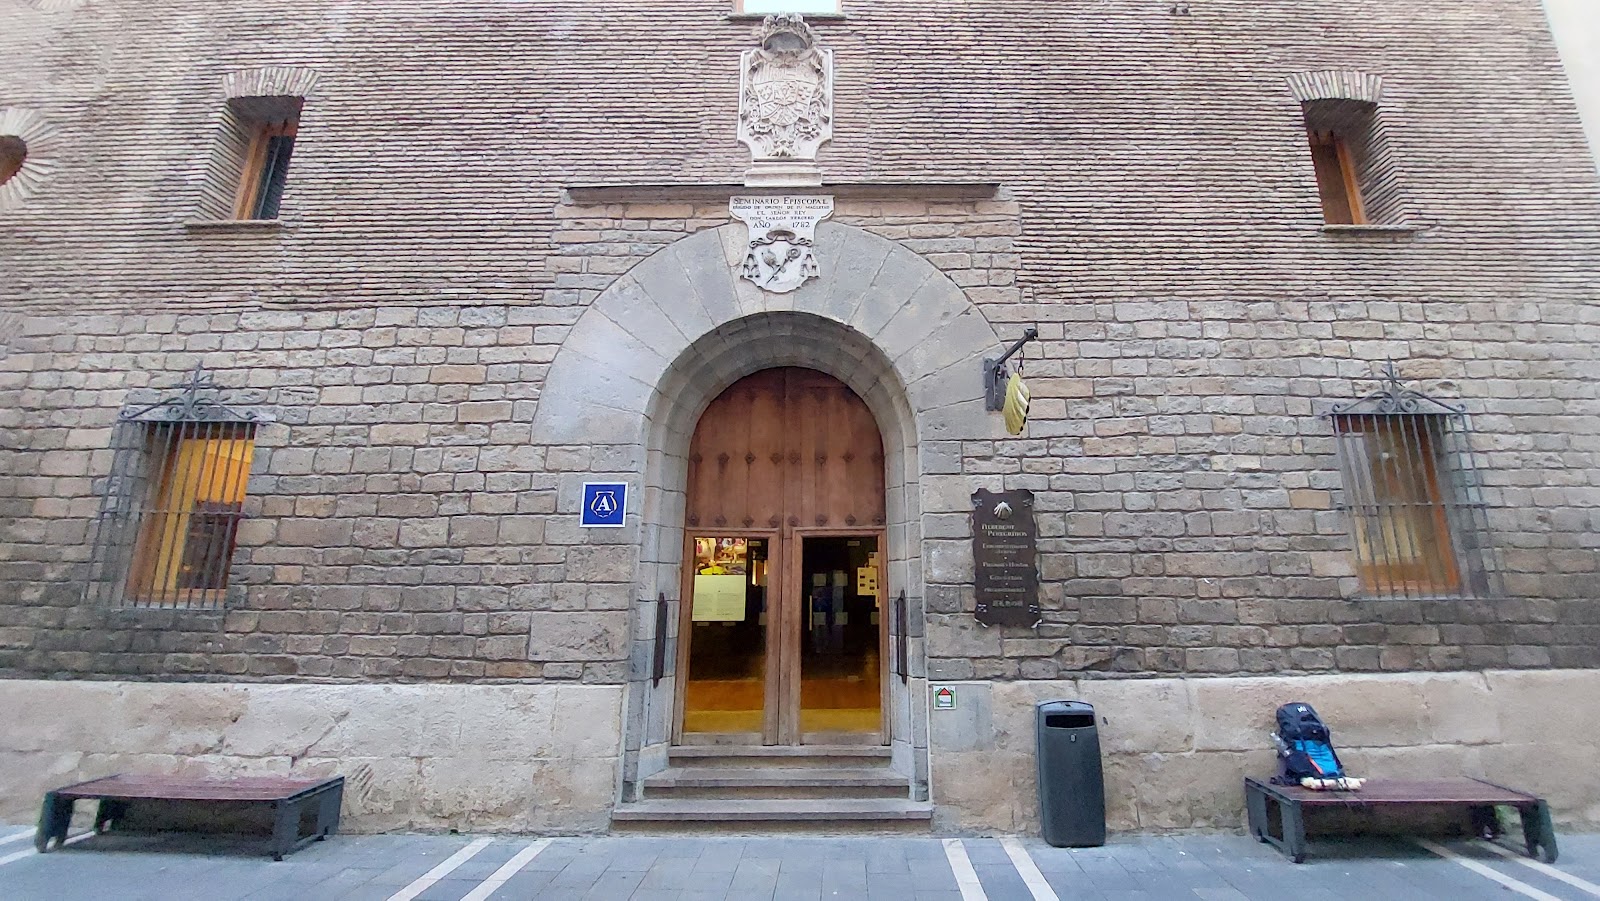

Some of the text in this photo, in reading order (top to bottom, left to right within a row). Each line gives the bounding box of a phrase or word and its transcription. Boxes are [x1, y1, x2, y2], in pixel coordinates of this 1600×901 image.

[733, 196, 828, 205] SEMINARIO EPISCOPAL
[752, 220, 771, 228] AÑO
[596, 495, 611, 511] A
